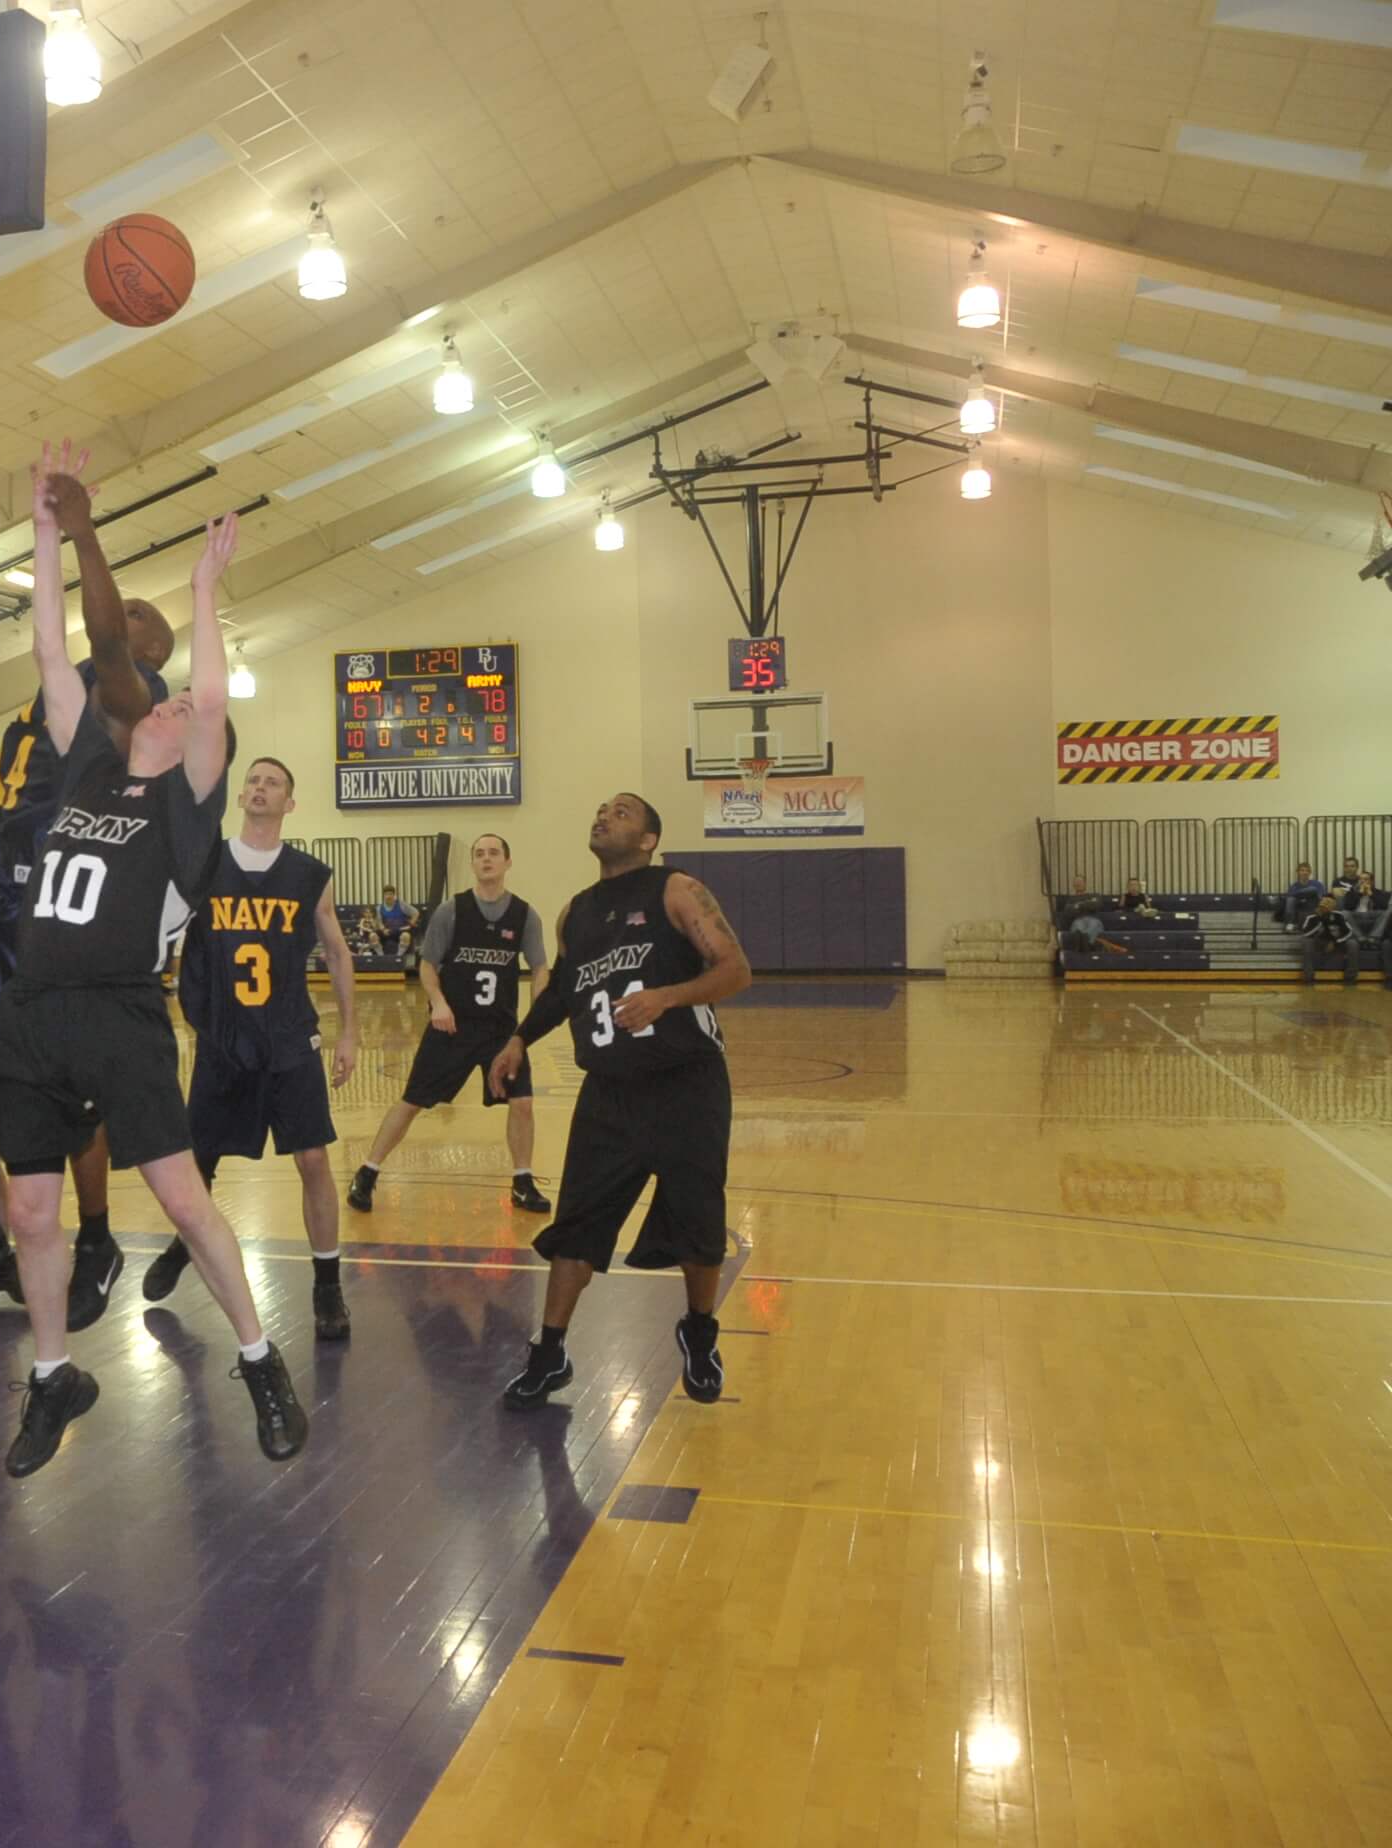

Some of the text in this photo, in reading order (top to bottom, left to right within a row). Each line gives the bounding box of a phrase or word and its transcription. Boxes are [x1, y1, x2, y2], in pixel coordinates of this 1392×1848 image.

[750, 641, 780, 657] 1:29
[415, 649, 457, 673] 1:29
[467, 675, 503, 688] ARMY
[742, 659, 775, 687] 35
[347, 681, 382, 693] NAVY
[353, 695, 383, 718] 67
[420, 695, 430, 713] 2
[478, 689, 505, 712] 78
[348, 730, 365, 748] 10
[417, 727, 428, 745] 4
[435, 726, 446, 744] 2
[462, 725, 473, 743] 4
[493, 724, 505, 742] 8
[1062, 737, 1271, 764] DANGER ZONE
[341, 767, 513, 799] BELLEVUE UNIVERSITY
[784, 791, 846, 811] MCAC
[33, 850, 108, 925] 10
[210, 897, 299, 933] NAVY
[454, 947, 516, 966] ARMY
[234, 943, 271, 1007] 3
[574, 943, 654, 992] ARMY
[475, 970, 497, 1006] 3
